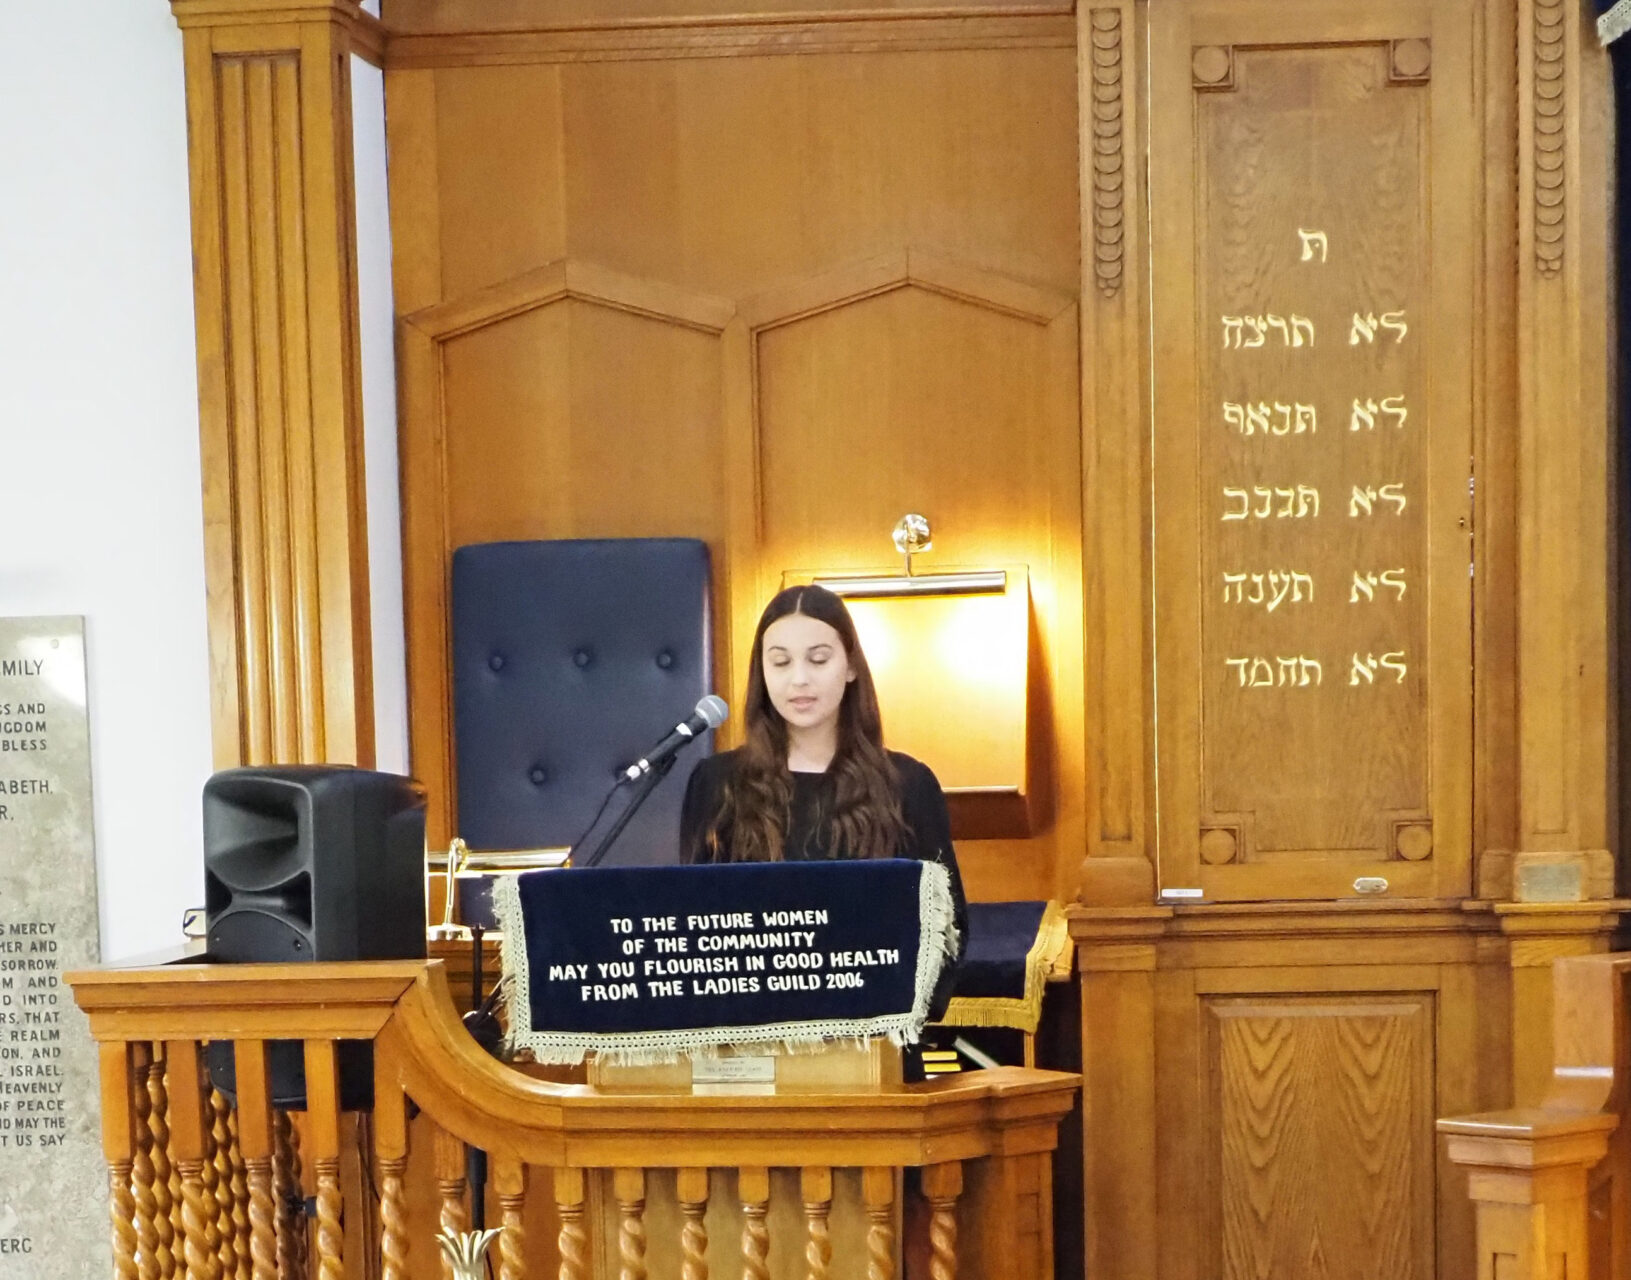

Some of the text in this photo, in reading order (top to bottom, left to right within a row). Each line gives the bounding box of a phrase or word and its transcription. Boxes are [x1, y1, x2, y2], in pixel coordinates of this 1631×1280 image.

[1221, 309, 1408, 349] לא תרצח
[1349, 394, 1408, 432] לא
[1348, 482, 1407, 518] לא
[1222, 567, 1407, 613] לא תענה
[0, 658, 43, 677] MILY
[1225, 650, 1408, 688] לא תחמד
[17, 702, 46, 715] AND
[0, 721, 46, 734] GDOM
[2, 738, 47, 752] BLESS
[610, 909, 829, 934] TO THE FUTURE WOMEN
[9, 922, 56, 935] MERCY
[30, 940, 57, 952] AND
[622, 931, 816, 955] OF THE COMMUNITY
[549, 948, 899, 981] MAY YOU FLOURISH IN GOOD HEALTH
[28, 976, 58, 988] AND
[581, 971, 865, 1001] FROM THE LADIES GUILD 2006
[23, 994, 57, 1005] INTO
[24, 1012, 60, 1024] THAT
[10, 1029, 60, 1041] REALM
[32, 1047, 61, 1059] AND
[17, 1100, 65, 1111] PEACE
[0, 1117, 65, 1129] D MAY THE
[16, 1134, 32, 1146] US
[39, 1134, 65, 1146] SAY
